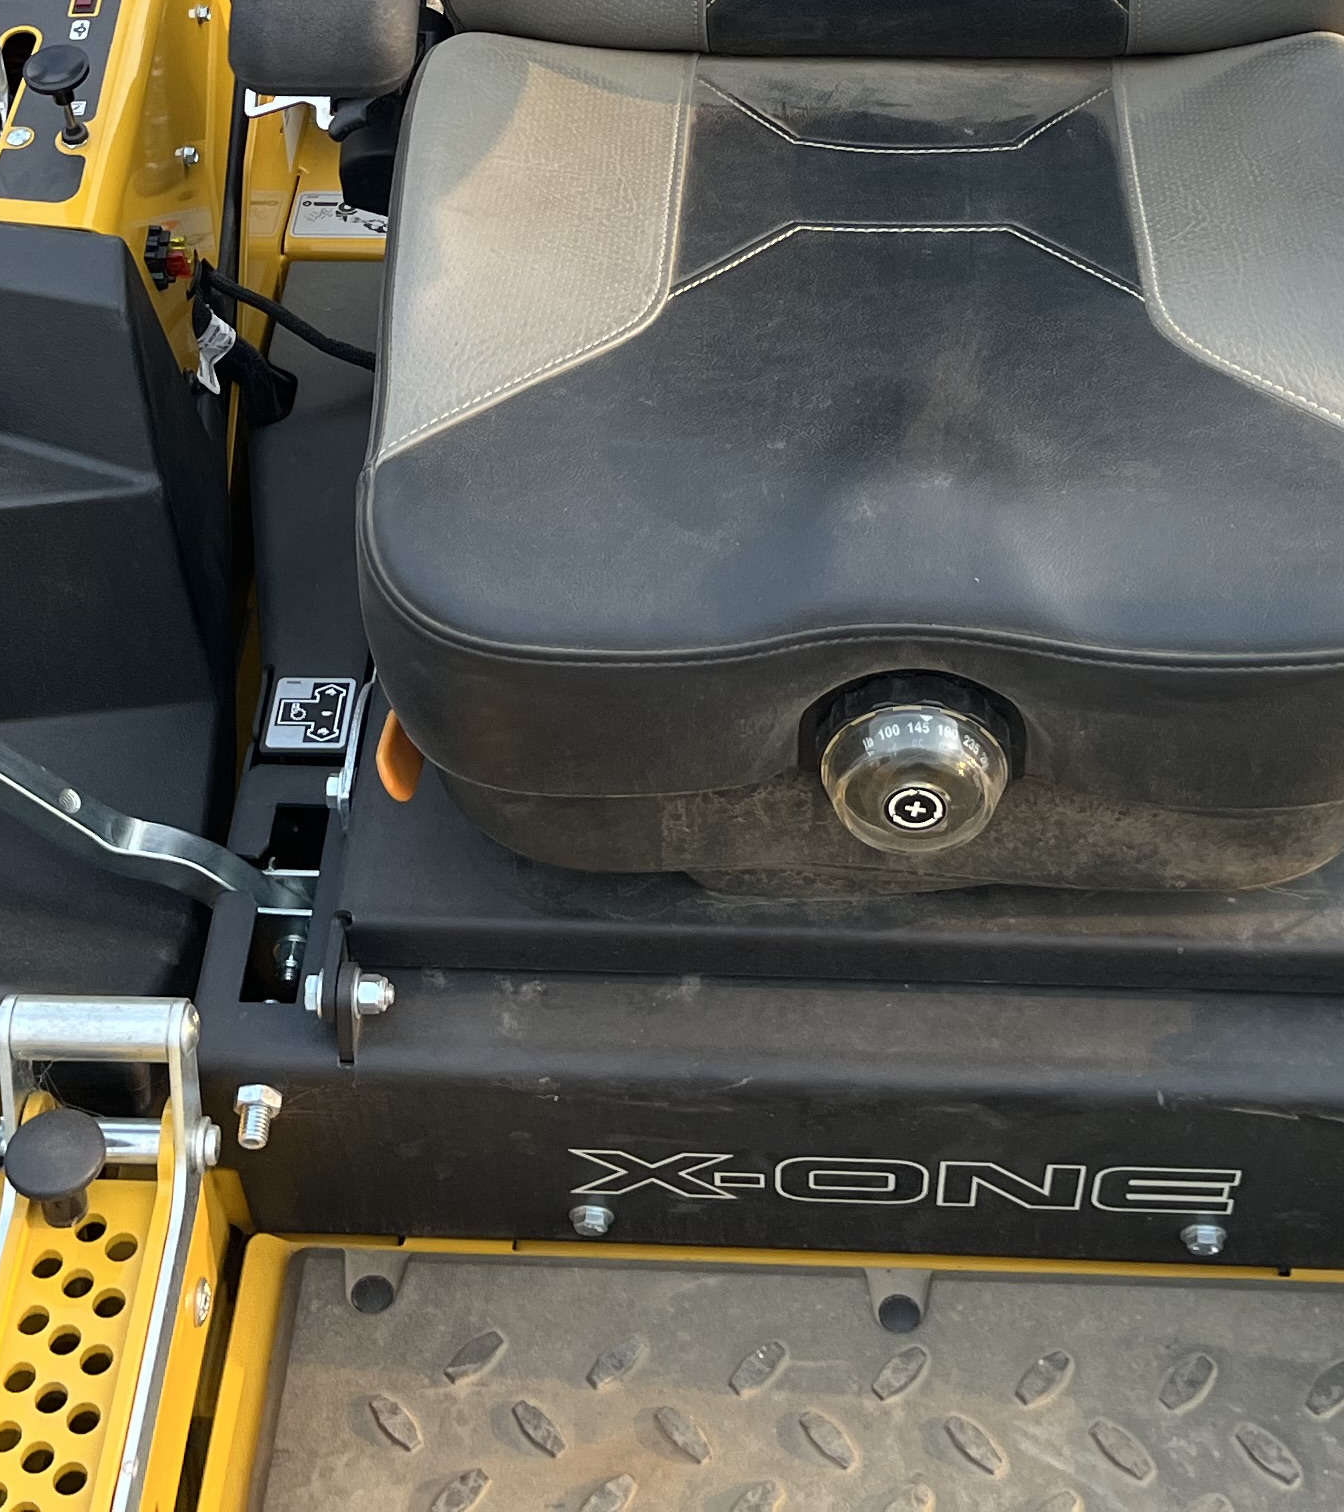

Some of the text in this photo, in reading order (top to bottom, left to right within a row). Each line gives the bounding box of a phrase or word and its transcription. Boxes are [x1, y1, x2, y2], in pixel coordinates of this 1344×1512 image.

[878, 723, 901, 741] 100
[907, 721, 930, 735] 145
[937, 723, 958, 740] 190
[962, 734, 981, 755] 235
[567, 1147, 1243, 1216] X-ONE
